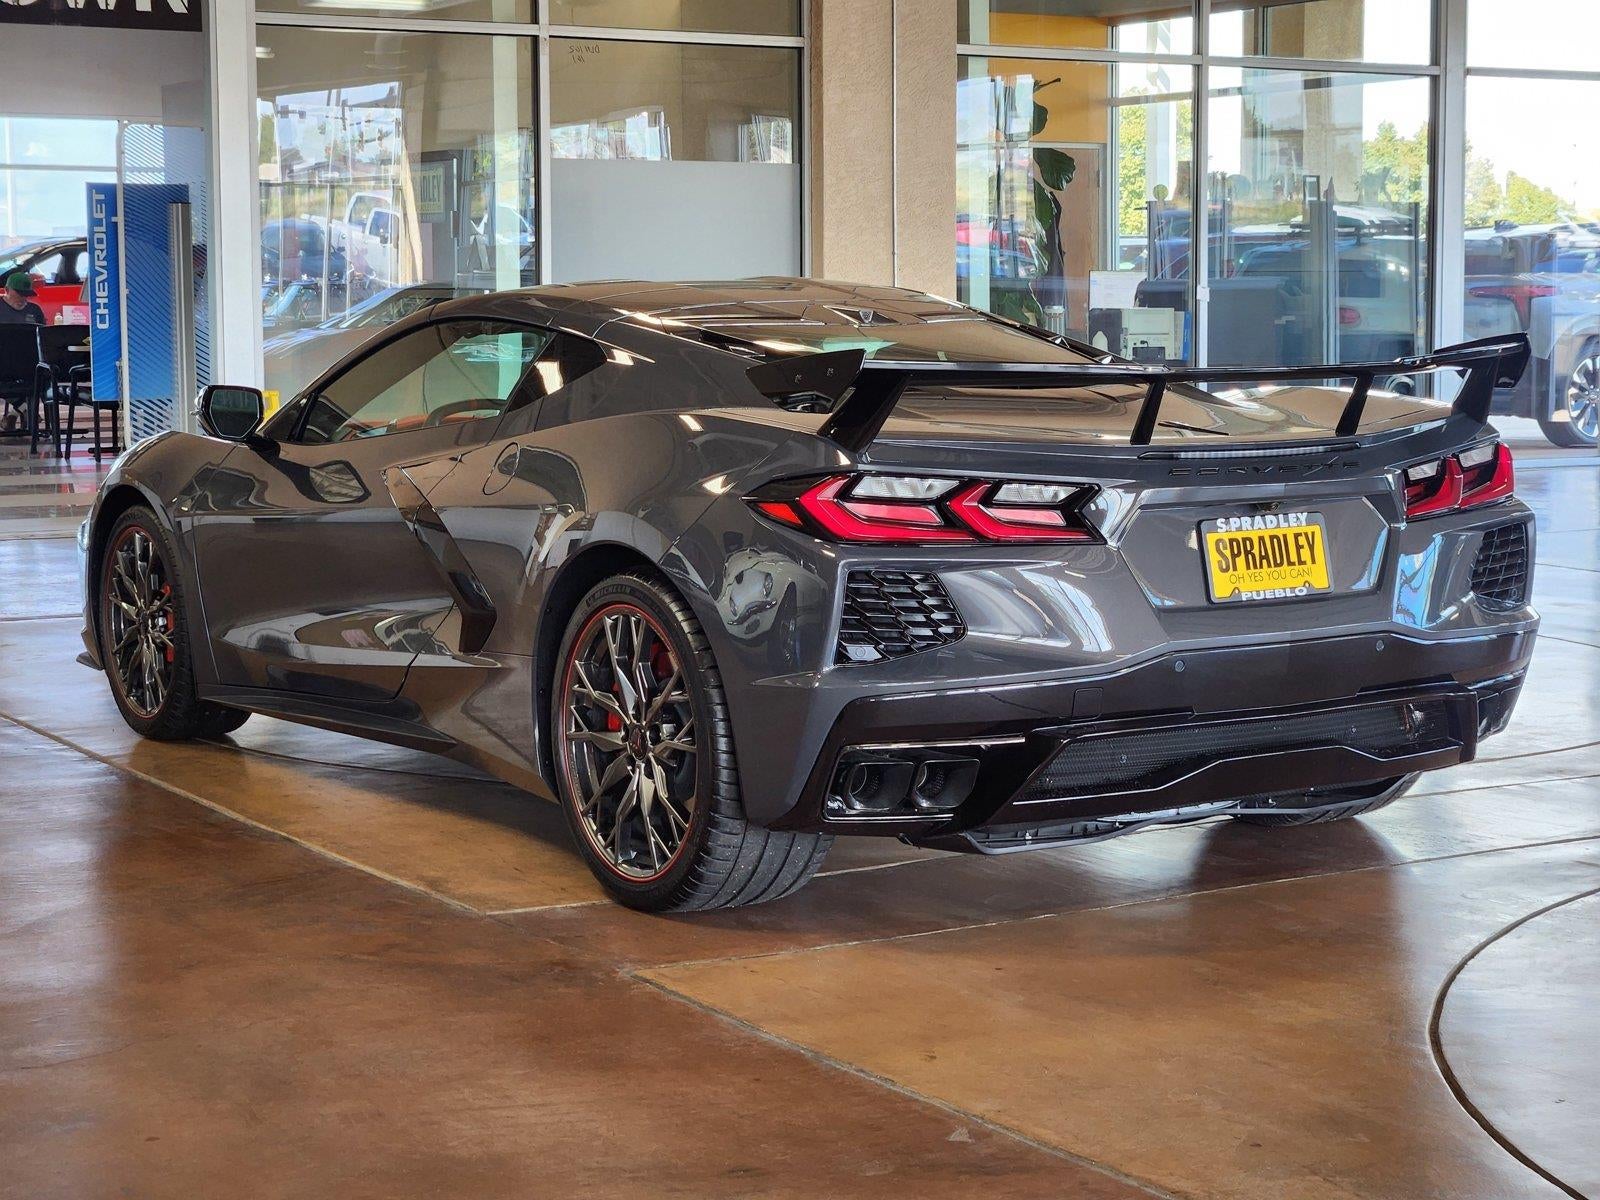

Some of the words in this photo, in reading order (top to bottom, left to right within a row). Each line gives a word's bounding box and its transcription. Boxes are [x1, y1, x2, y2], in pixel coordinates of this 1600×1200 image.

[93, 189, 110, 330] CHEVROLET
[1168, 456, 1361, 477] CORVETTE
[1216, 512, 1308, 533] SPRADLEY
[1215, 531, 1317, 573] SPRADLEY
[1229, 573, 1246, 585] OH
[1247, 571, 1264, 583] YES
[1266, 569, 1288, 581] YOU
[1289, 567, 1313, 579] CAN!
[1241, 586, 1308, 601] PUEBLO
